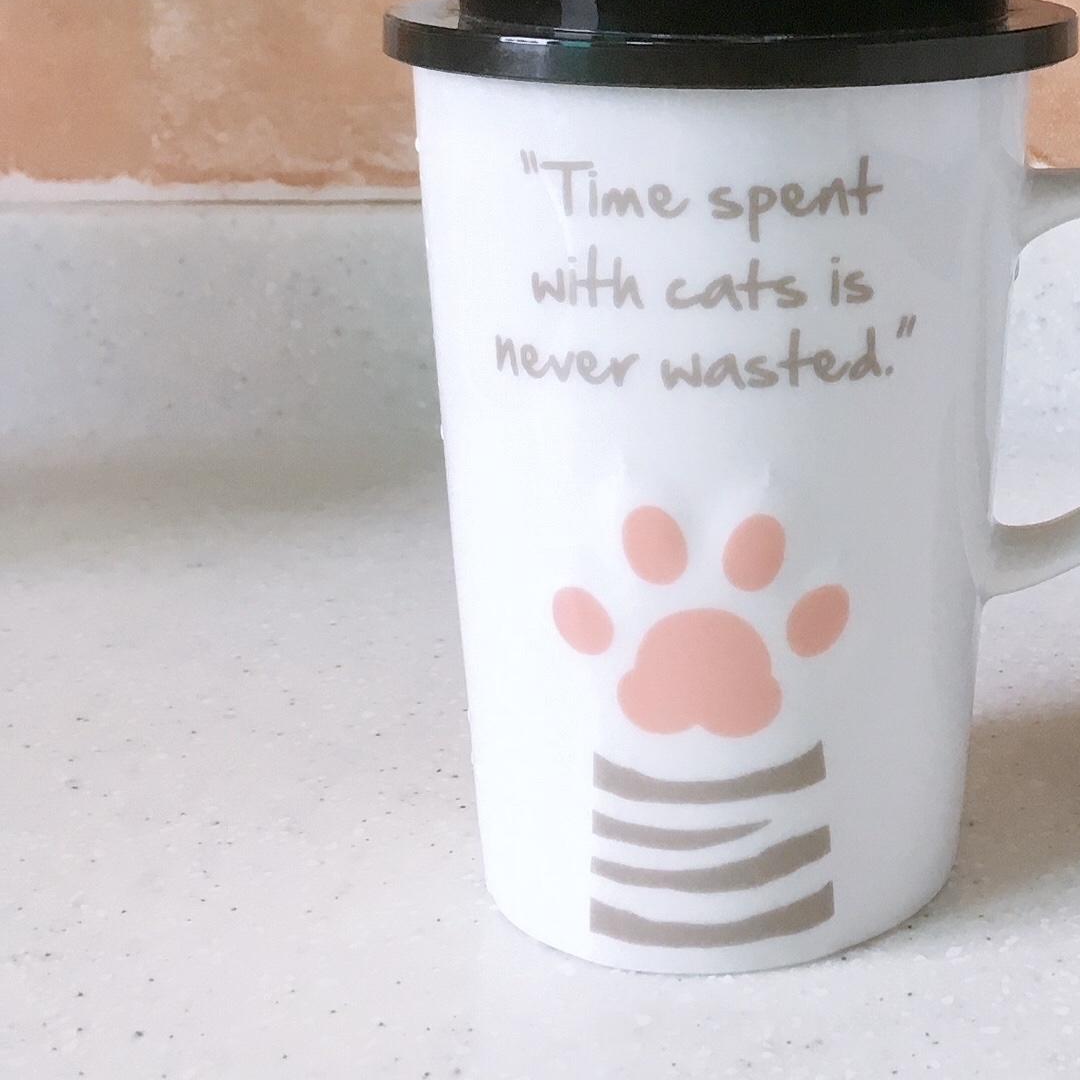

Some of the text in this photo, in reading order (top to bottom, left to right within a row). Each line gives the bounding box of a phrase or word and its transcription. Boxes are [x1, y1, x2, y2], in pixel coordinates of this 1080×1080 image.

[708, 155, 884, 243] spent
[531, 244, 874, 311] with cats is
[495, 334, 640, 387] never
